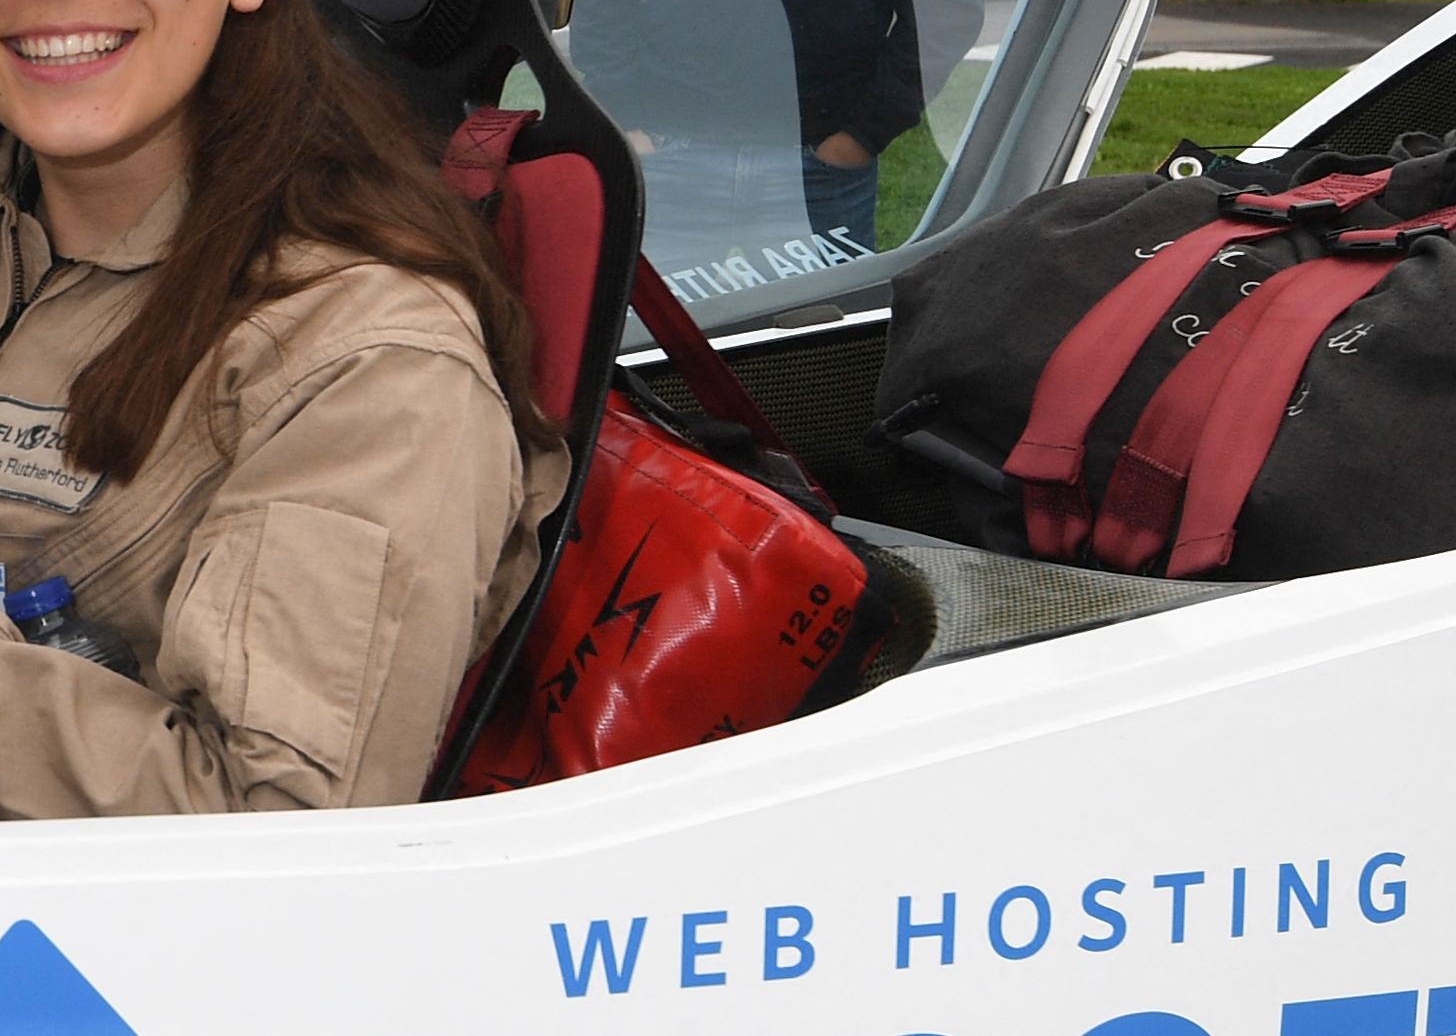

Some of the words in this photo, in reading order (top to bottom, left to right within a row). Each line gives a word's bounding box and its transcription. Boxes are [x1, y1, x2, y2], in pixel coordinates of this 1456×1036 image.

[3, 458, 89, 493] Rutherford
[778, 583, 832, 647] 12.0
[800, 604, 854, 671] LBS
[551, 905, 815, 998] WEB
[896, 852, 1407, 969] HOSTING
